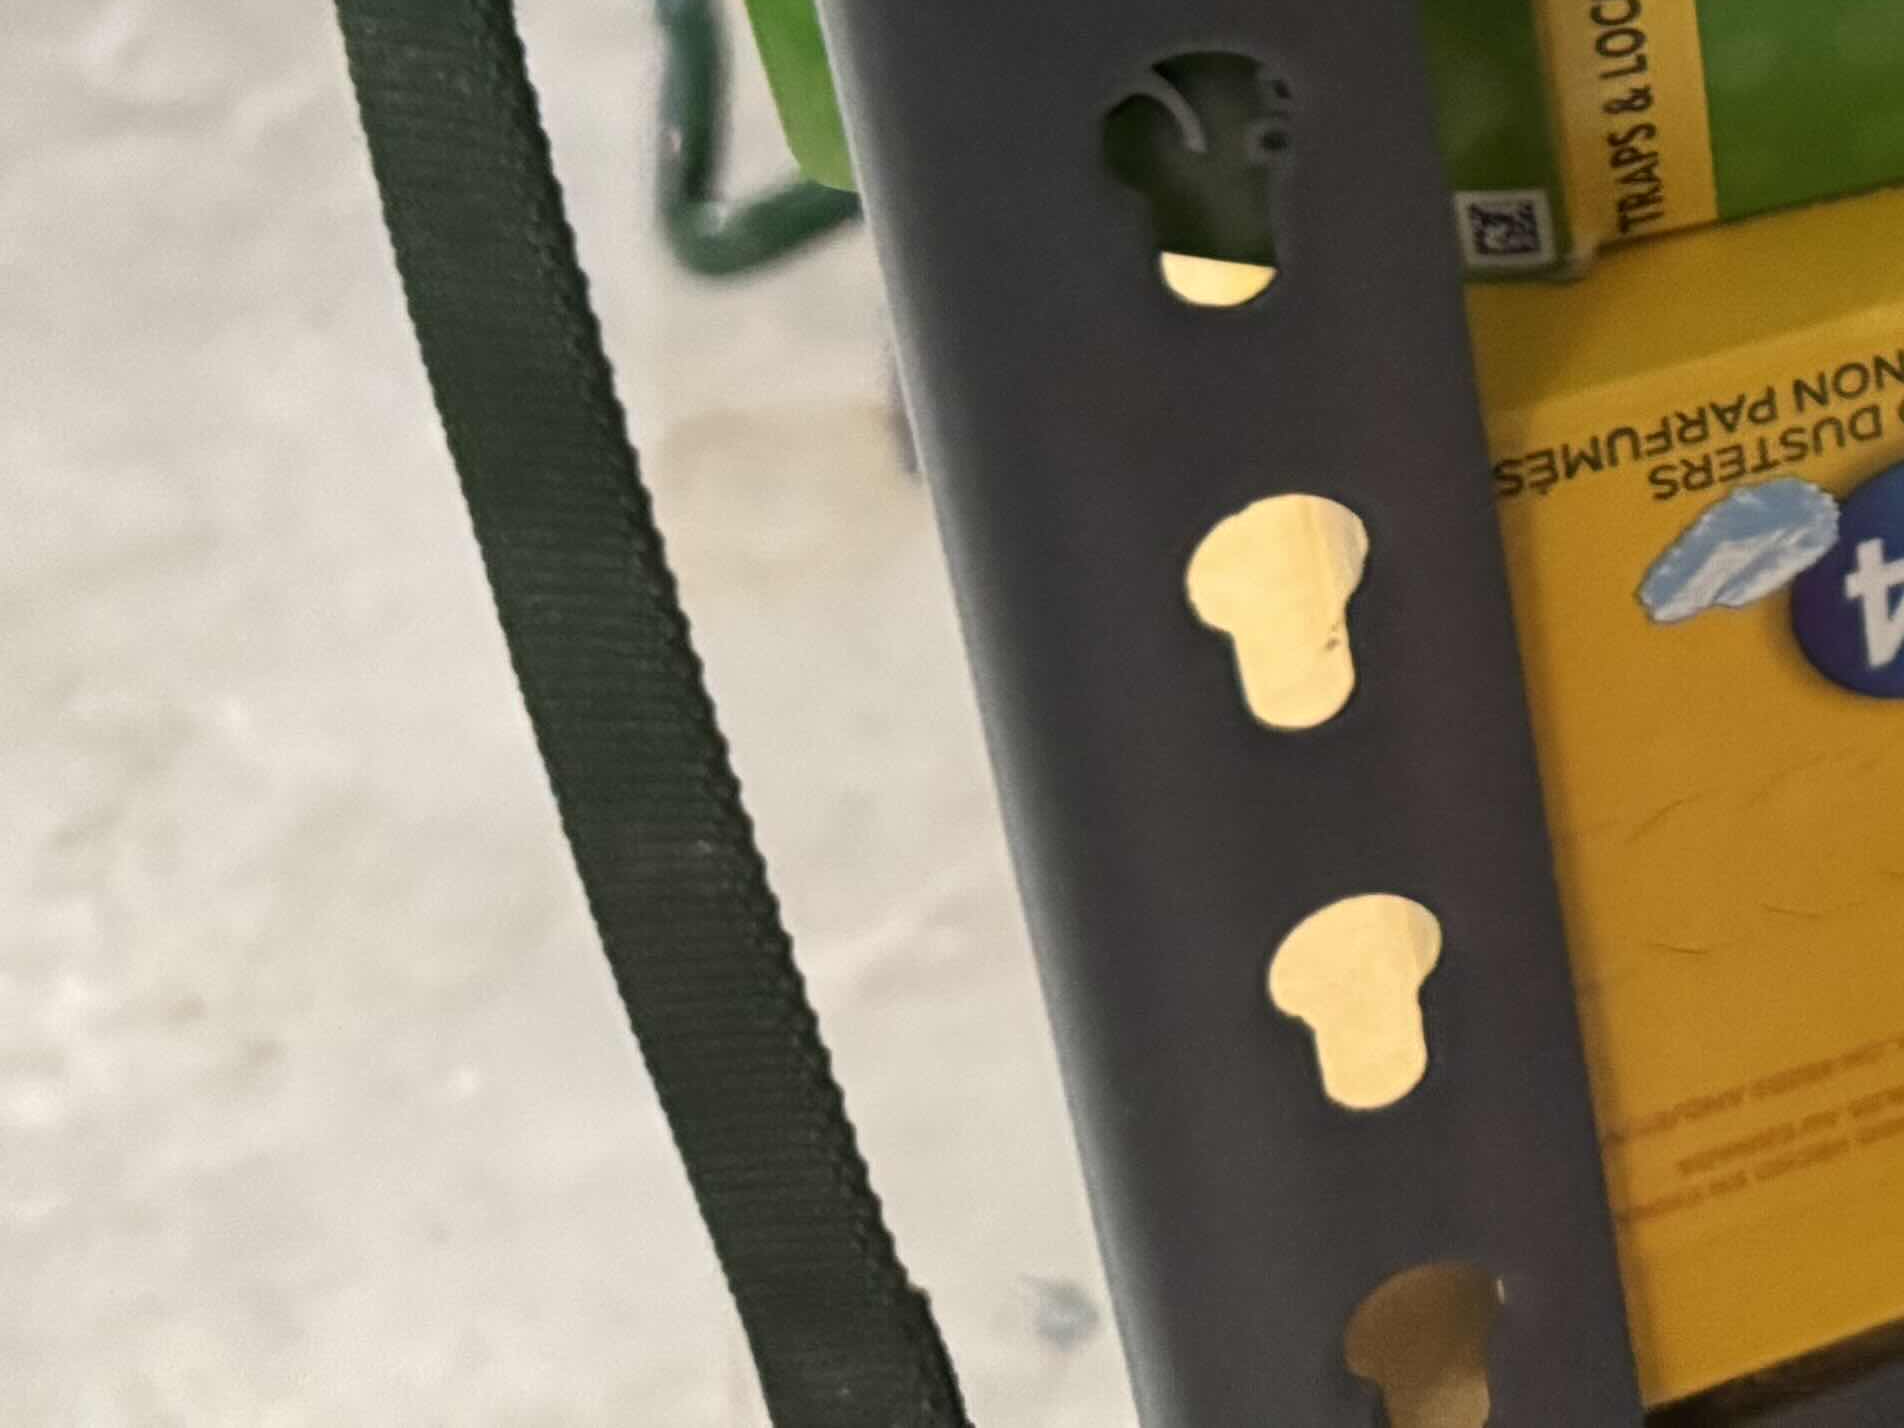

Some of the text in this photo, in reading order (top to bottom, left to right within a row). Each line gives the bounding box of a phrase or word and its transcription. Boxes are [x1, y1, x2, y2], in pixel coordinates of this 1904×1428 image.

[1604, 87, 1650, 112] &
[1608, 124, 1668, 233] TRAPS
[1492, 387, 1775, 499] PARFUMÉS
[1647, 403, 1884, 497] DUSTERS
